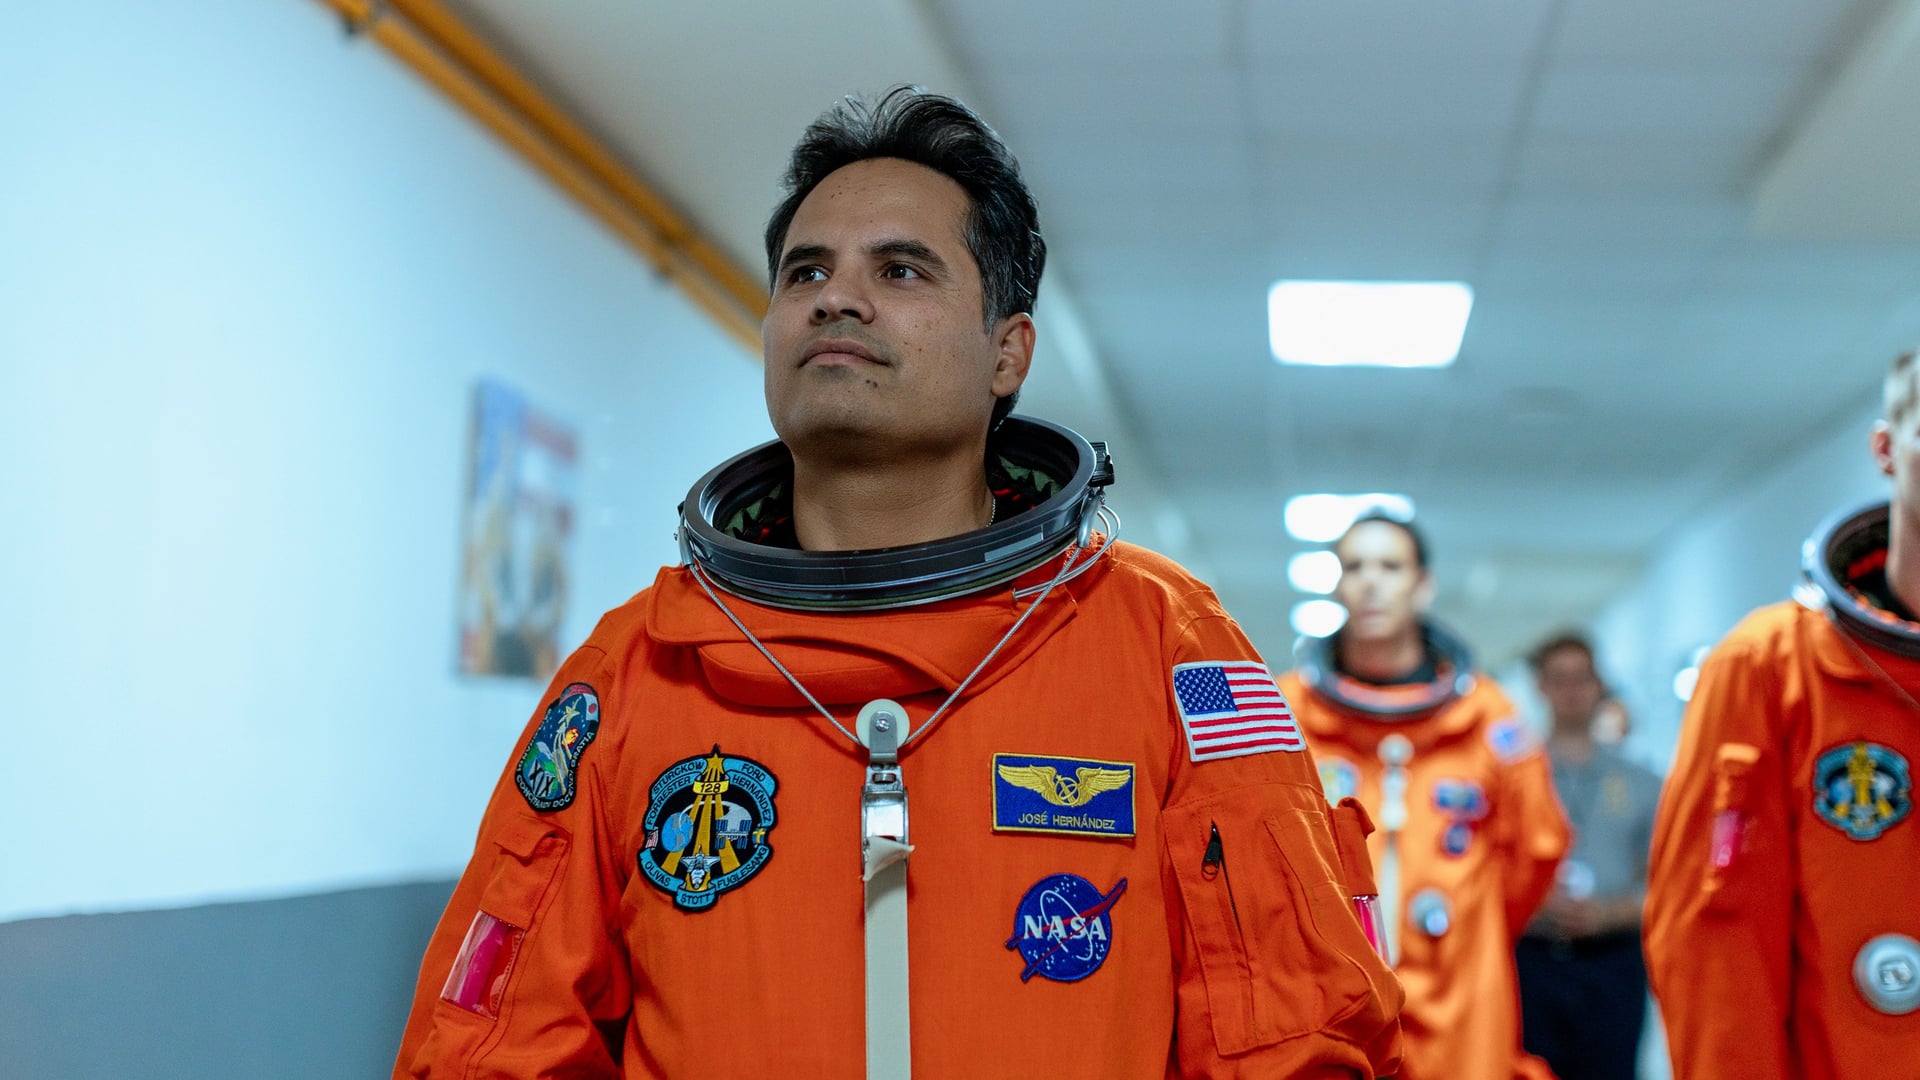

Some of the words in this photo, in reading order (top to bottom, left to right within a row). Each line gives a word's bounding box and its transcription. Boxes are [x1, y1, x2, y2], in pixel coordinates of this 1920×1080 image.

[653, 761, 705, 795] STURCKOW
[741, 763, 766, 782] FORD
[699, 782, 721, 793] 128
[647, 775, 691, 826] FORRESTER
[1018, 811, 1048, 825] JOSÉ
[1053, 814, 1115, 829] HERNÁNDEZ
[644, 861, 671, 887] OLIVAS
[717, 847, 767, 889] FUGLESANG
[680, 892, 711, 905] STOTT
[1023, 915, 1107, 940] NASA
